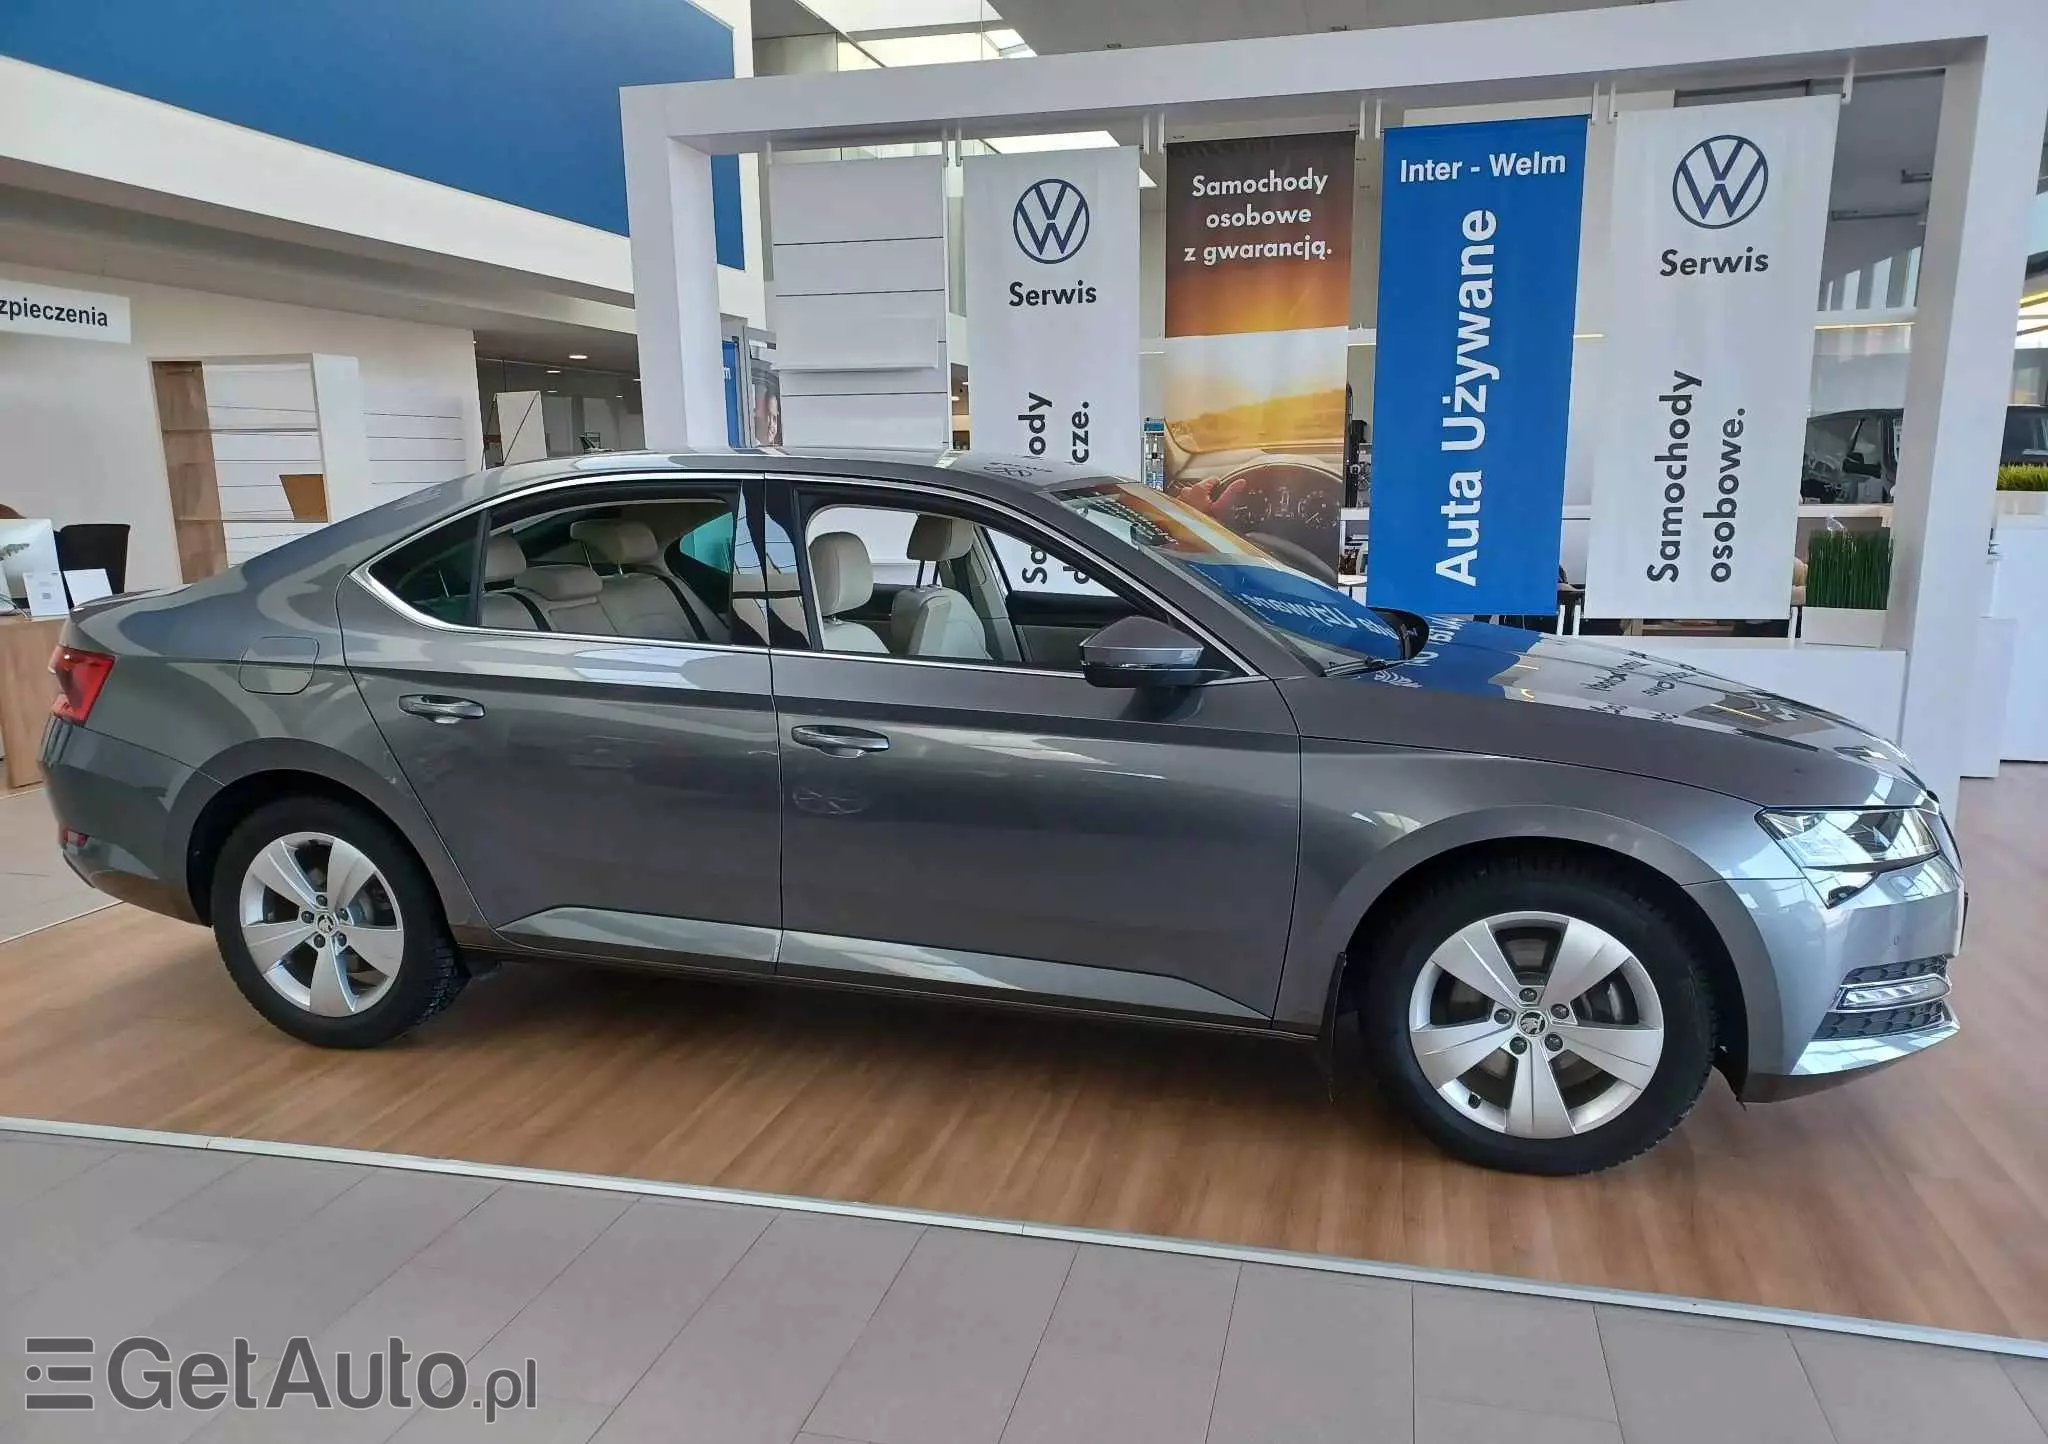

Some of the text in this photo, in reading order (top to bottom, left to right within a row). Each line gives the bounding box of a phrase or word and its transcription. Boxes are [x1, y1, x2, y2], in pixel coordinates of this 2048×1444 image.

[1191, 166, 1329, 198] Samochody
[1399, 158, 1464, 184] Inter
[1488, 151, 1567, 177] Welm
[1205, 203, 1312, 229] osobowe
[1183, 234, 1333, 266] z gwarancją.
[1659, 246, 1770, 278] Serwis
[1008, 279, 1097, 308] Serwis
[1440, 209, 1500, 452] Używane
[1646, 369, 1703, 584] Samochody
[1702, 408, 1746, 583] osobowe.
[1435, 469, 1484, 587] Auta
